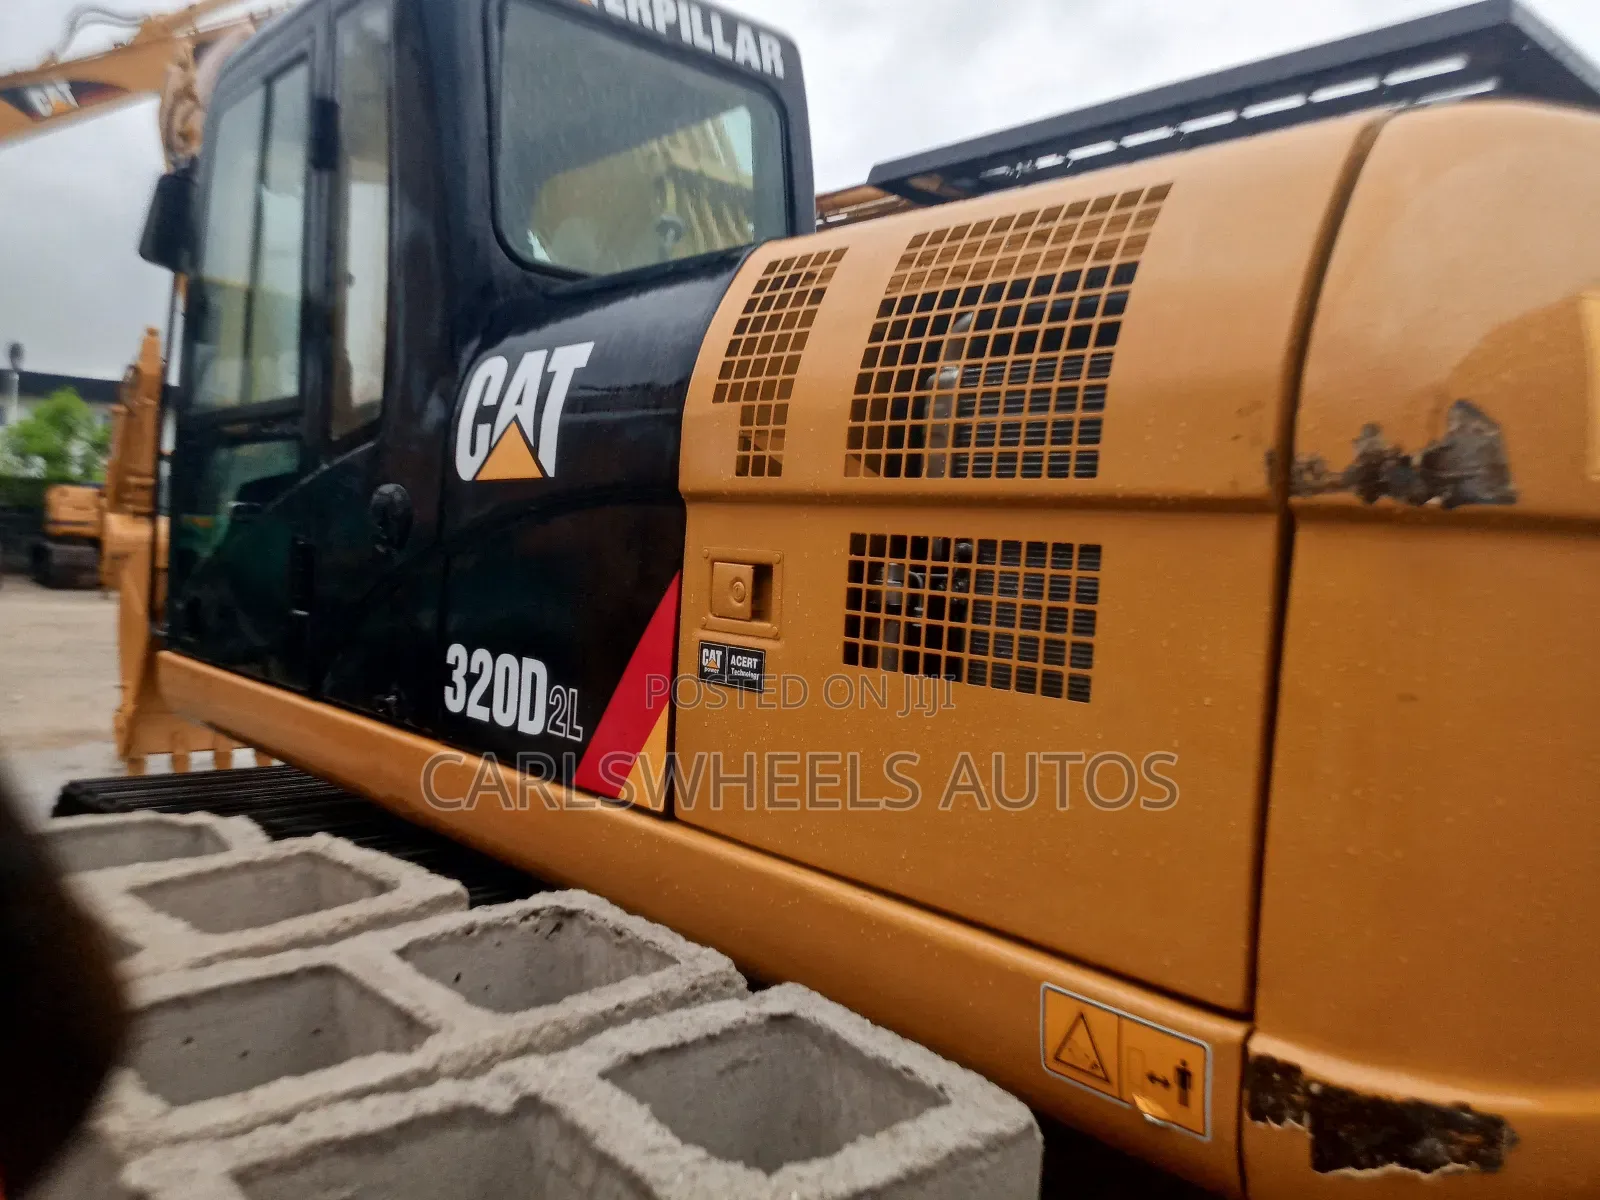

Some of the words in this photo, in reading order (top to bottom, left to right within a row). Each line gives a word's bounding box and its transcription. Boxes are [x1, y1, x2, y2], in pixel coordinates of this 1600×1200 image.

[25, 78, 80, 118] CAT
[455, 341, 595, 482] CAT
[702, 648, 723, 669] CAT
[730, 654, 758, 670] ACERT
[704, 666, 719, 674] power
[731, 667, 760, 681] Technology
